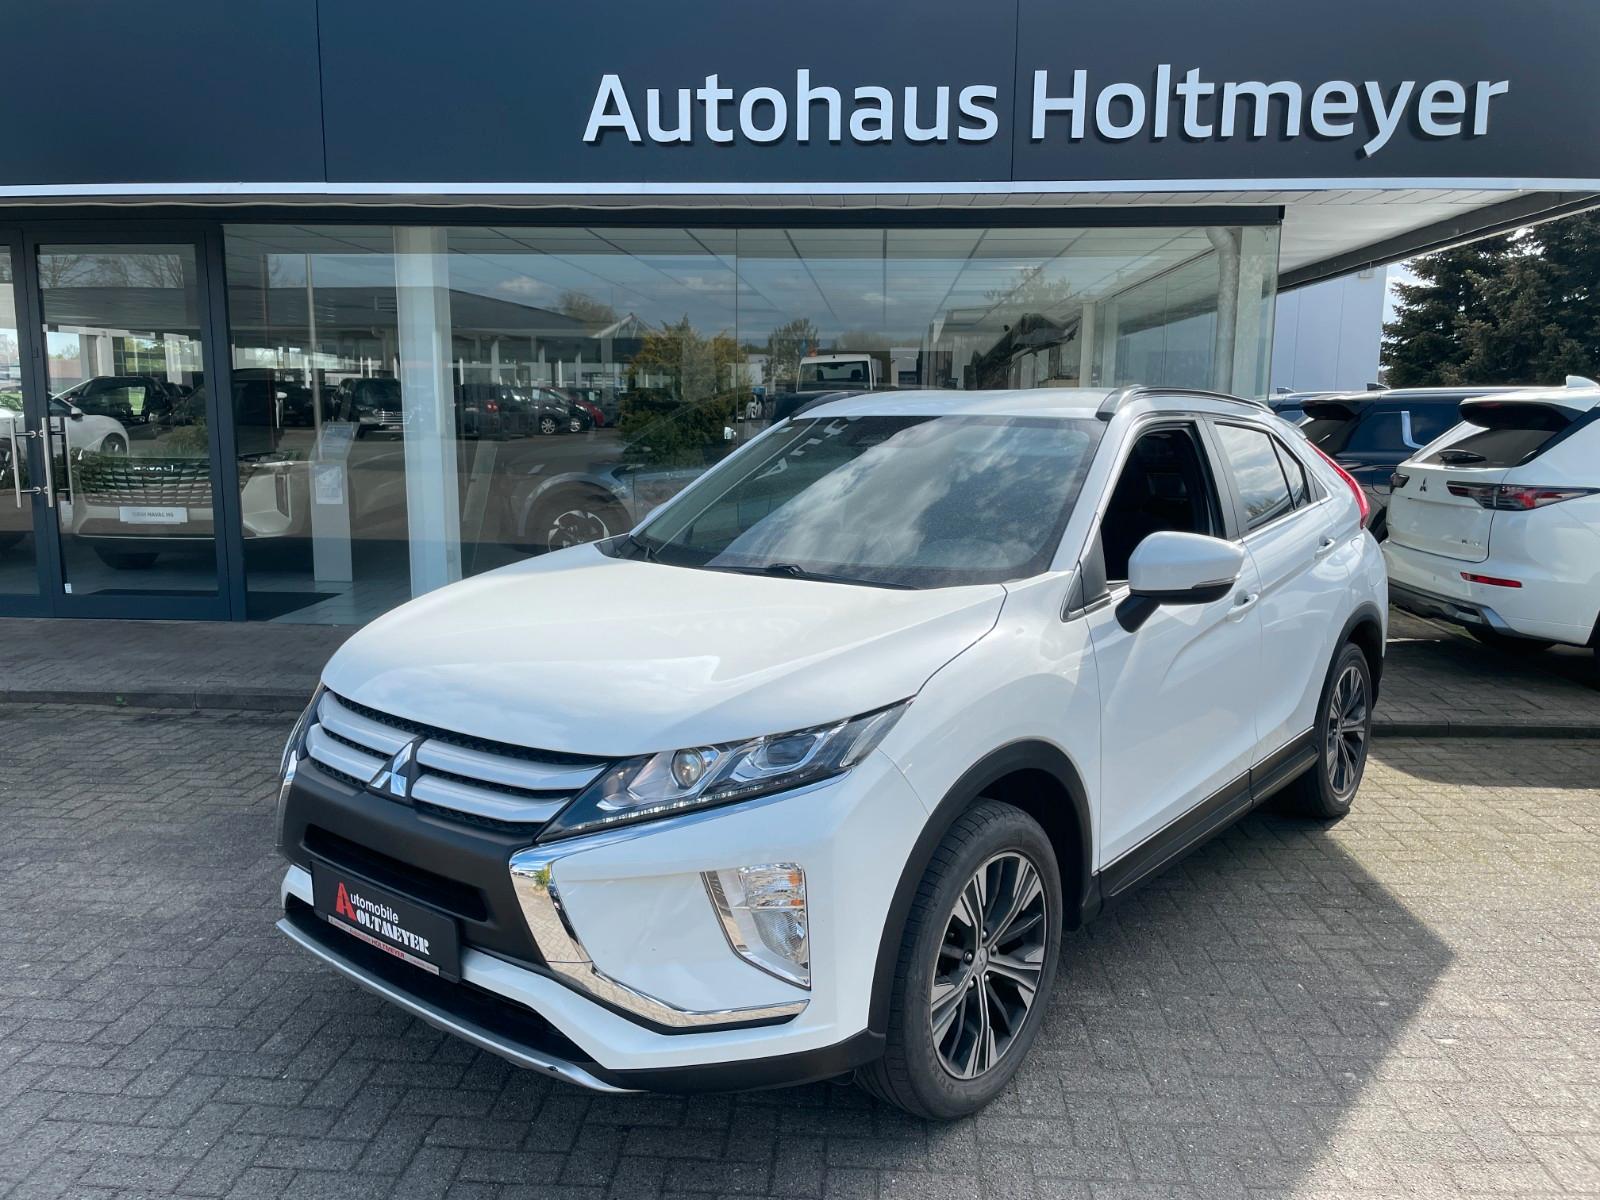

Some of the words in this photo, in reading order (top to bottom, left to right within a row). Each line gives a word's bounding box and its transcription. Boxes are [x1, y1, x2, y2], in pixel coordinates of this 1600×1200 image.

[583, 69, 997, 142] Autohaus
[1032, 64, 1508, 155] Holtmeyer
[336, 882, 399, 924] Automobile
